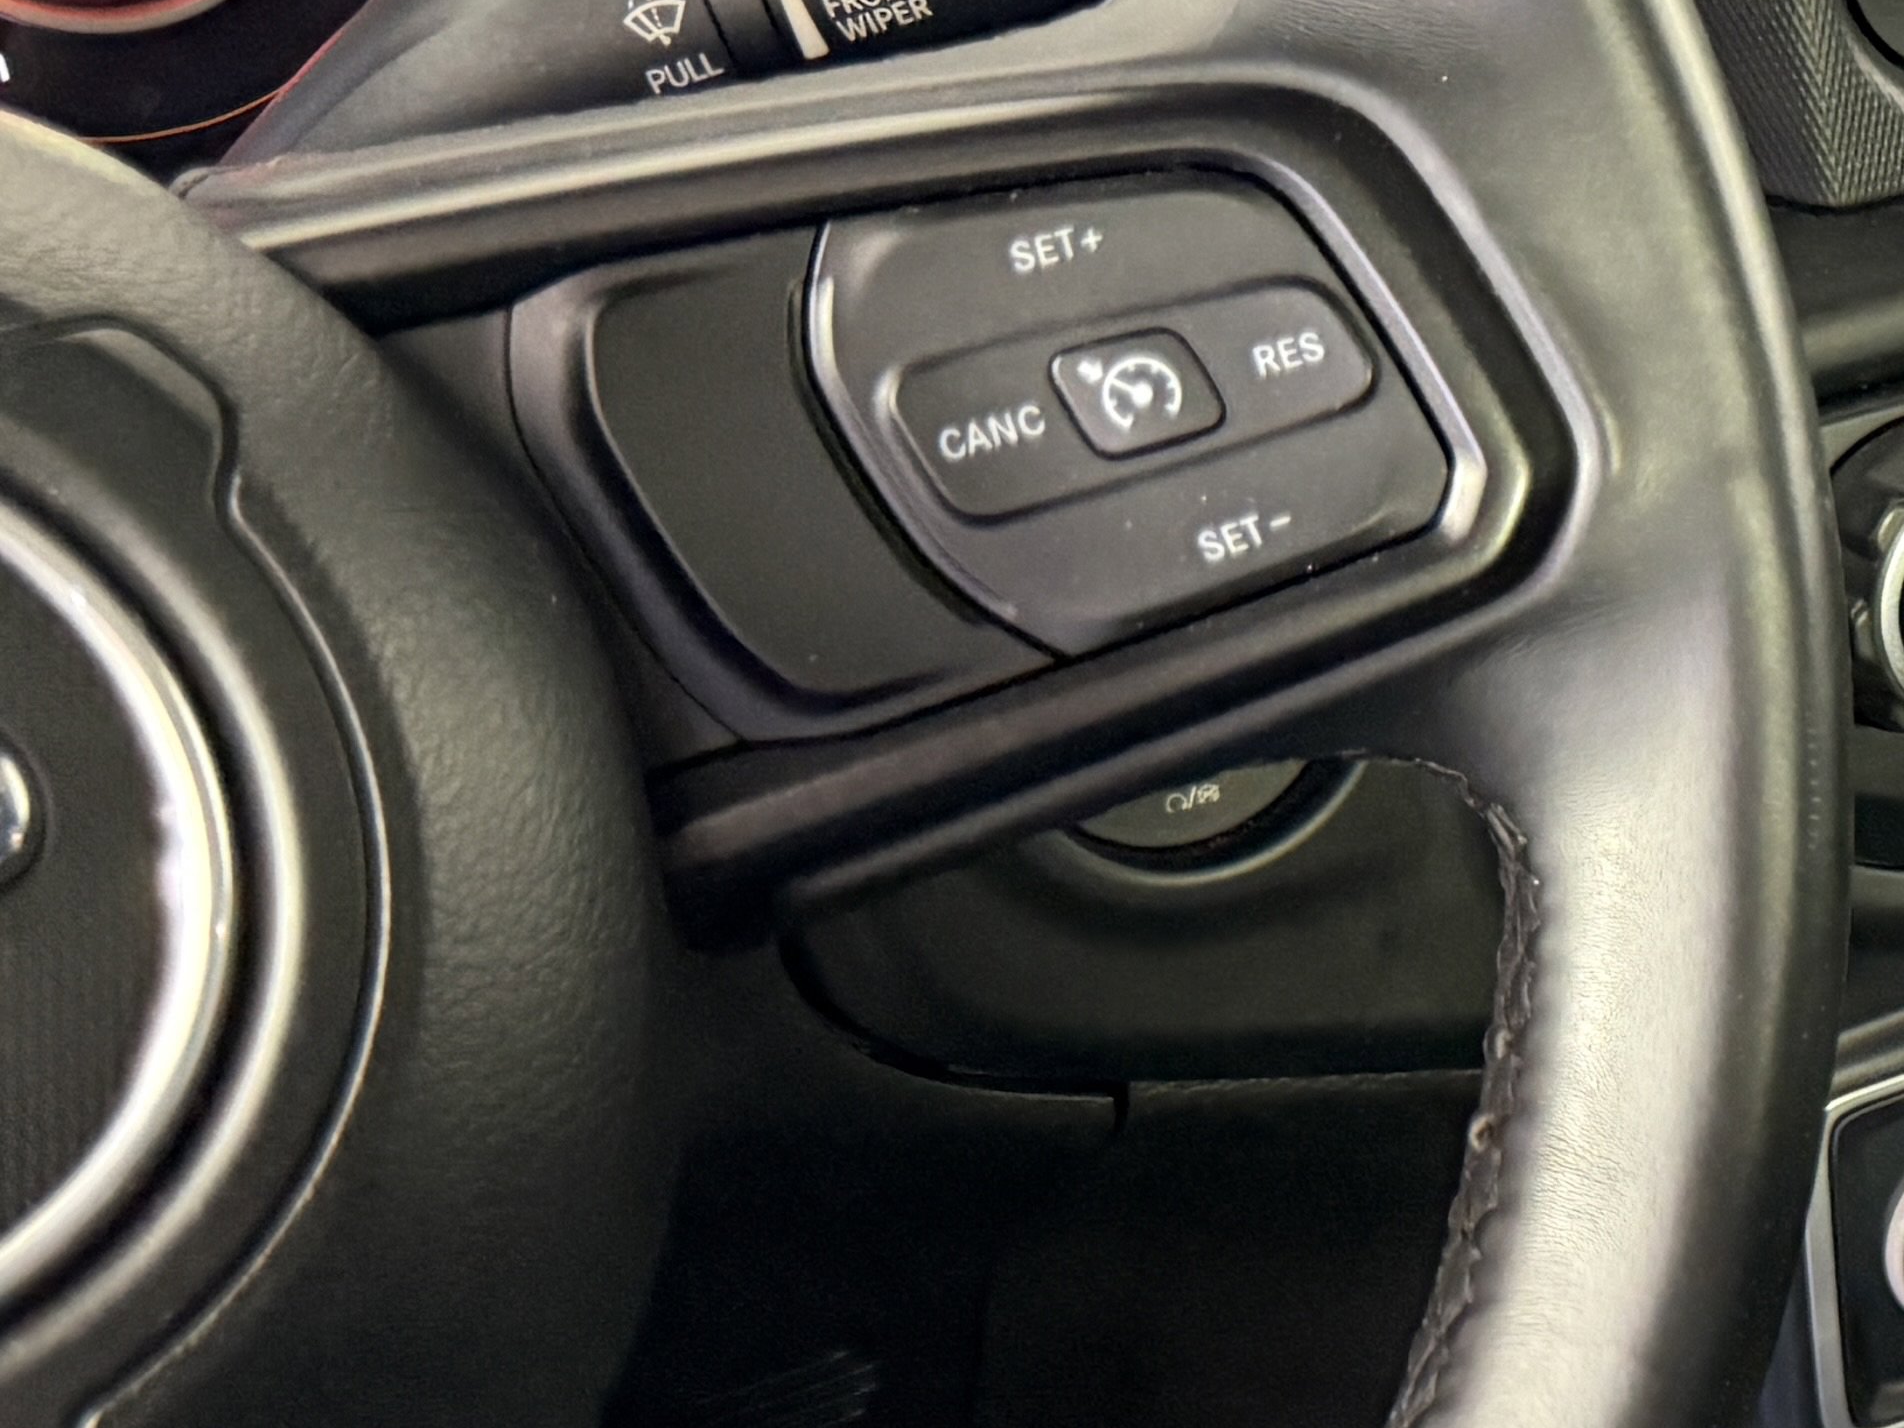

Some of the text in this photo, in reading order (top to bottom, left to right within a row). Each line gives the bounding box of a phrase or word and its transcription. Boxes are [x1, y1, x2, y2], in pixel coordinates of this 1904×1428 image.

[645, 54, 725, 94] PULL
[1253, 332, 1325, 378] RES
[939, 404, 1046, 462] CANC
